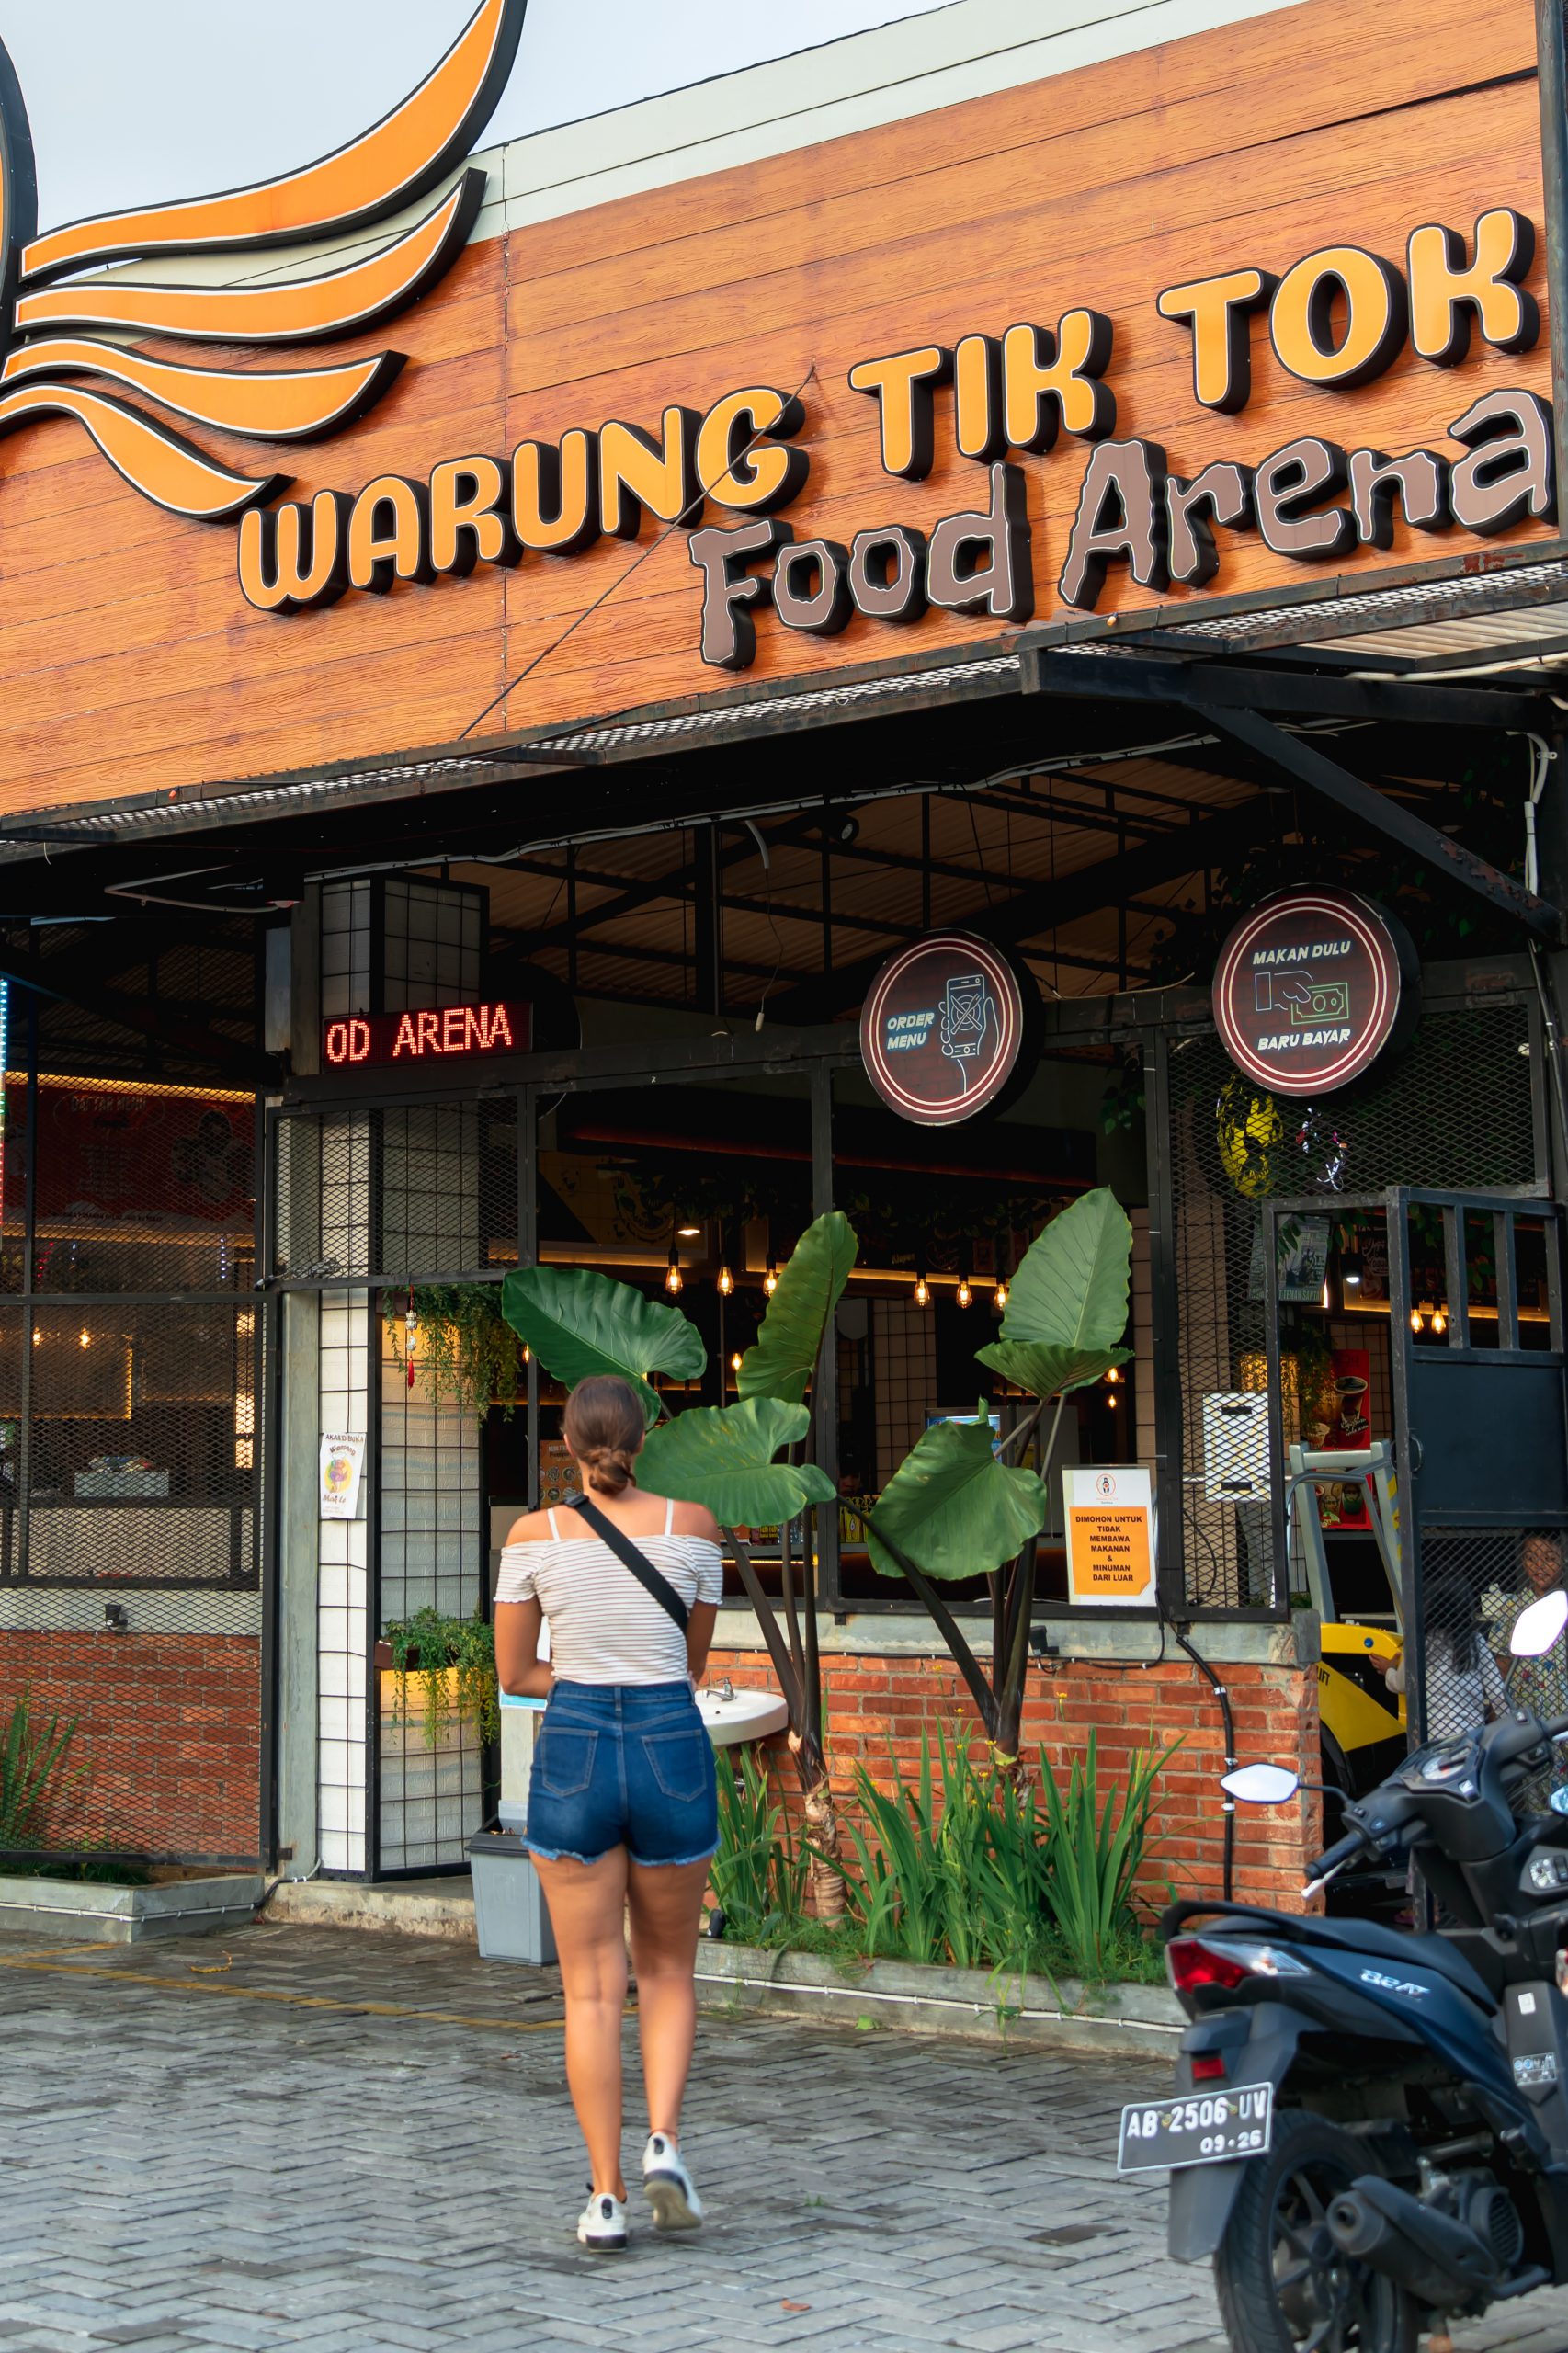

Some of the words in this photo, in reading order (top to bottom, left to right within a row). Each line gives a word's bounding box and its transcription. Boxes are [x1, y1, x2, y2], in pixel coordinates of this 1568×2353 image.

[238, 385, 807, 614] WARUNG
[848, 307, 1115, 479] TIK
[1157, 207, 1539, 414] TOK
[689, 460, 1034, 669] Food
[1059, 388, 1557, 610] Arena
[1253, 946, 1309, 965] MAKAN
[1312, 941, 1351, 958] DULU
[327, 1019, 369, 1062] OD
[392, 1004, 512, 1056] ARENA
[887, 1012, 935, 1031] ORDER
[887, 1032, 926, 1050] MENU
[1257, 1032, 1299, 1051] BARU
[1302, 1029, 1351, 1046] BAYAR
[1316, 1665, 1330, 1686] IFT
[1127, 2110, 1158, 2138] AB
[1168, 2097, 1228, 2132] 2506
[1239, 2090, 1267, 2120] UV
